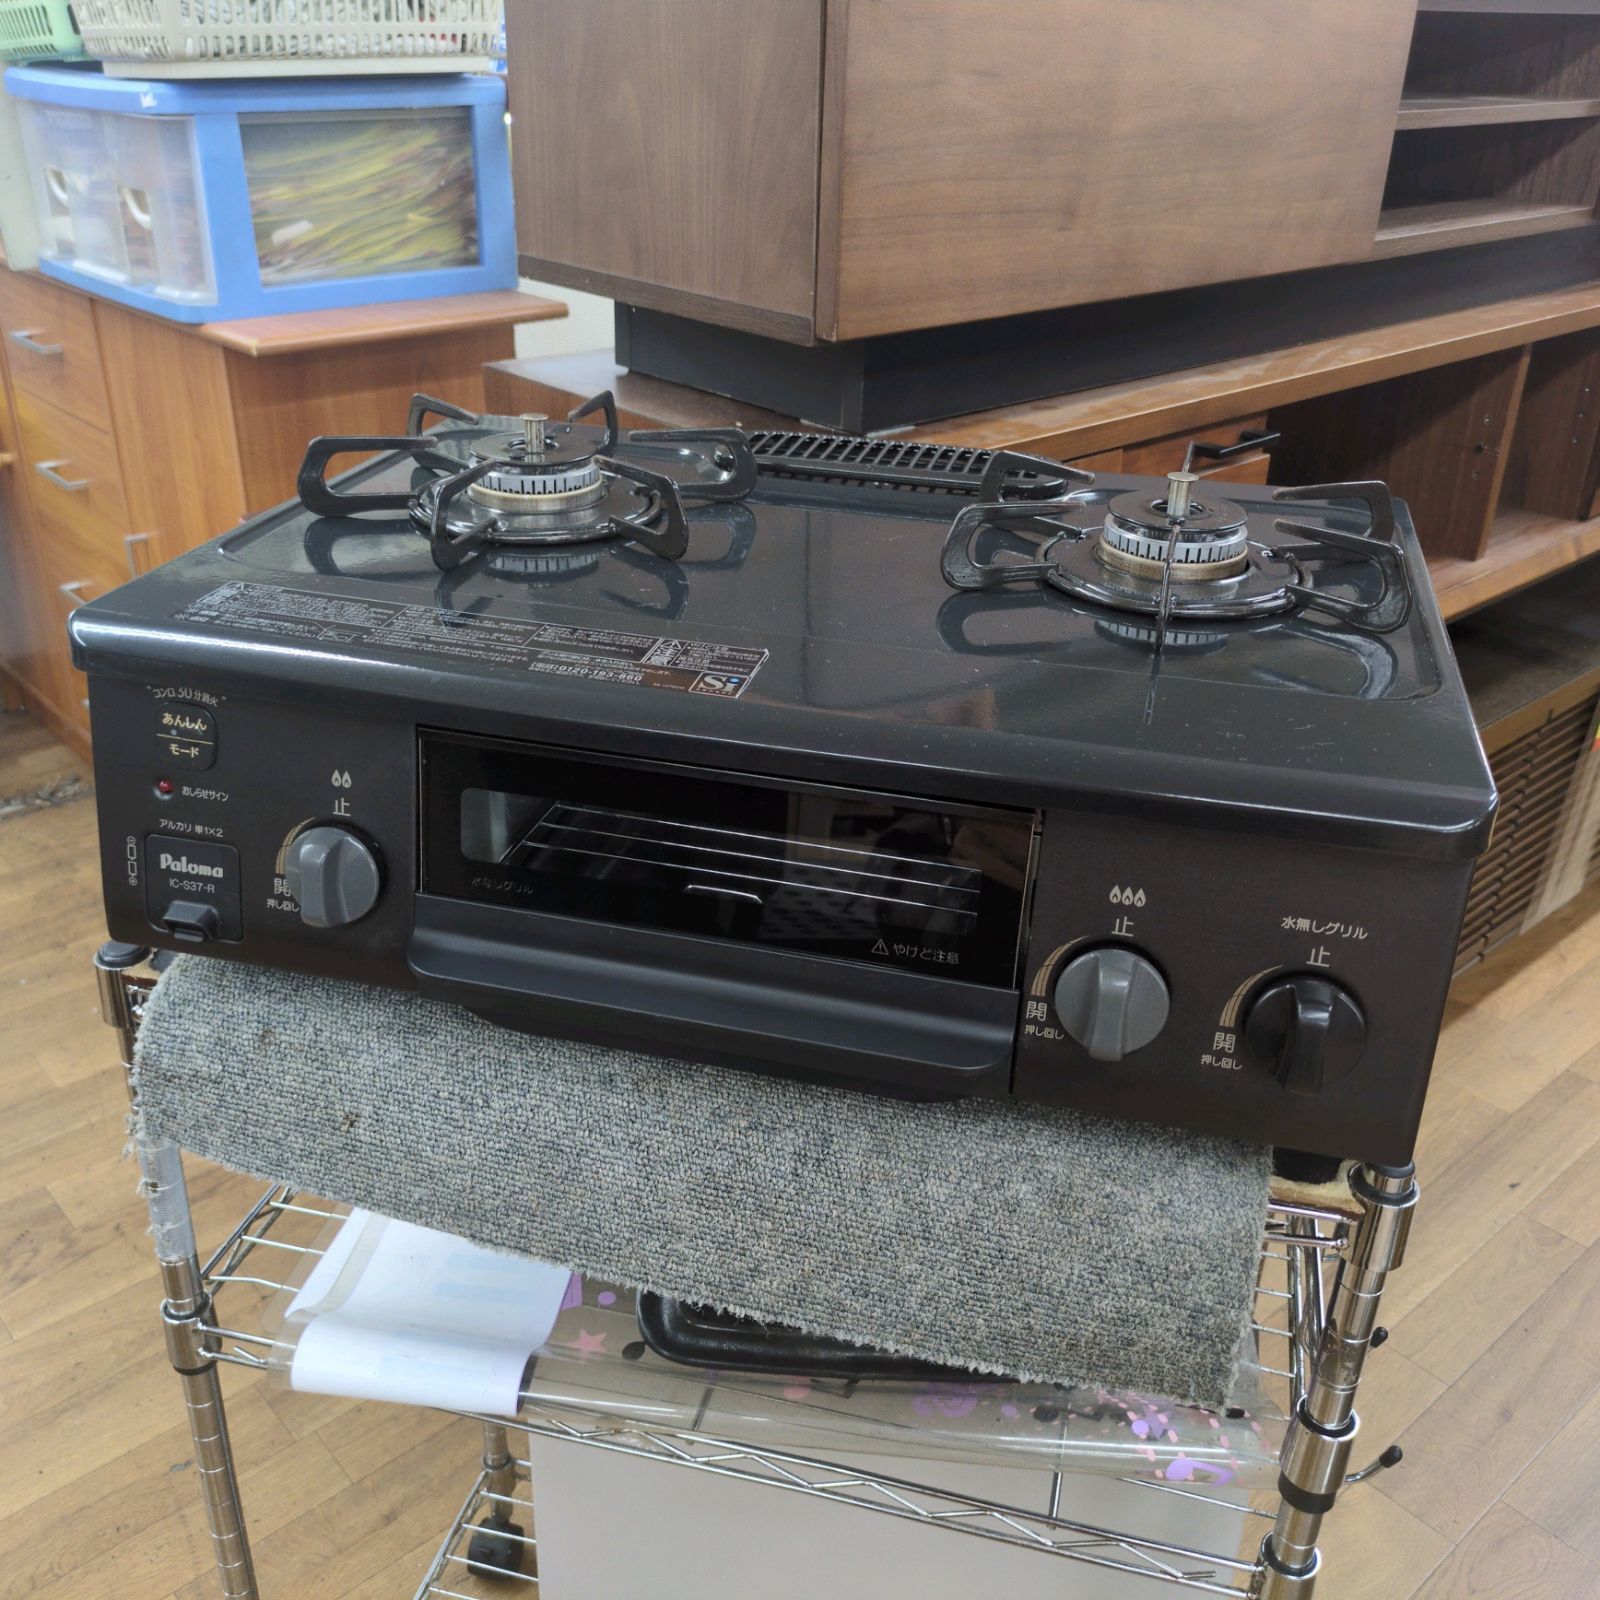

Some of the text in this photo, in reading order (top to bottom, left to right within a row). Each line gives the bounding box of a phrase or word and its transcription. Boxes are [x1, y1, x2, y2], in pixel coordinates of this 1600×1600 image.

[162, 712, 207, 731] あんしん
[169, 743, 199, 758] モード
[182, 786, 229, 802] おしらせサイン
[332, 797, 352, 817] 止
[159, 818, 192, 832] アルカリ
[159, 853, 224, 878] Paloma
[169, 877, 215, 894] IC-S37-R
[1111, 915, 1135, 937] 止
[1281, 915, 1369, 940] 水無しグリル
[893, 943, 960, 965] やけど注意
[1306, 945, 1331, 968] 止
[1025, 1000, 1048, 1022] 開
[1024, 1023, 1065, 1040] 押し回し
[1212, 1031, 1236, 1054] 開
[1200, 1053, 1243, 1071] 押し回し
